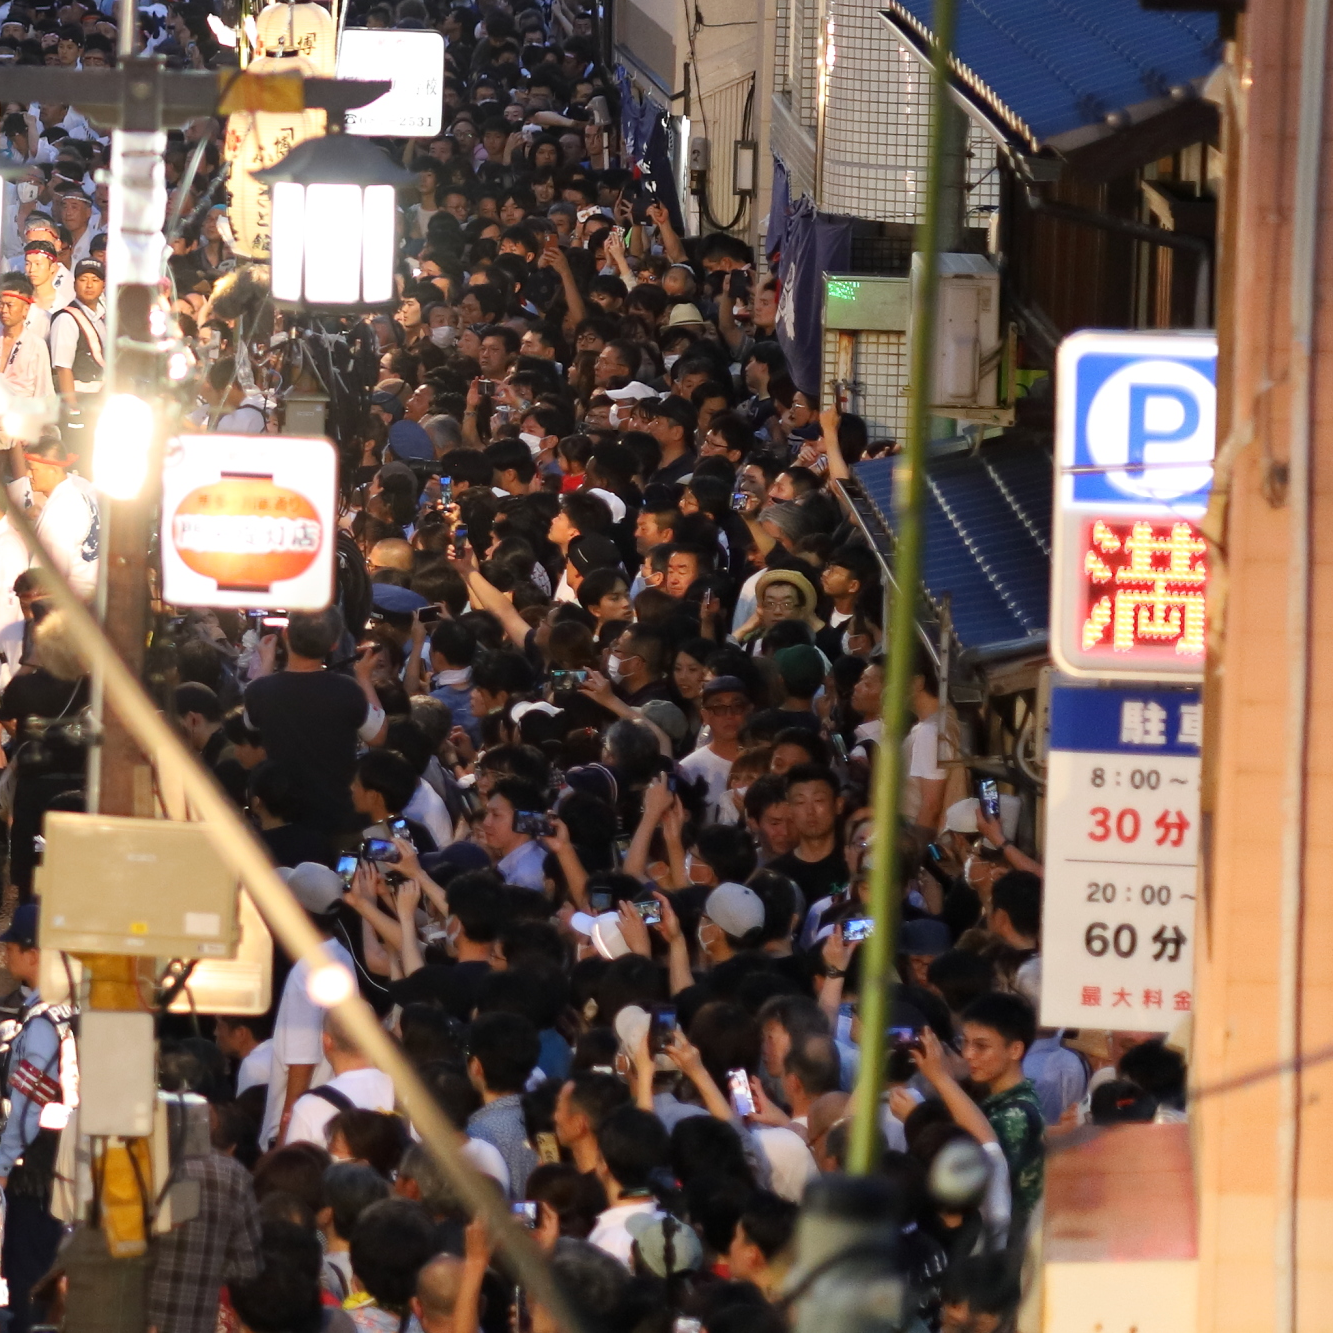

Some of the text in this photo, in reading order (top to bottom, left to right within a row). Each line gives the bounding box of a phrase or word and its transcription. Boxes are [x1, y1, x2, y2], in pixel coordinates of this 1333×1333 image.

[1123, 384, 1200, 479] P
[1083, 520, 1206, 655] 満
[1081, 986, 1192, 1013] 最大料金
